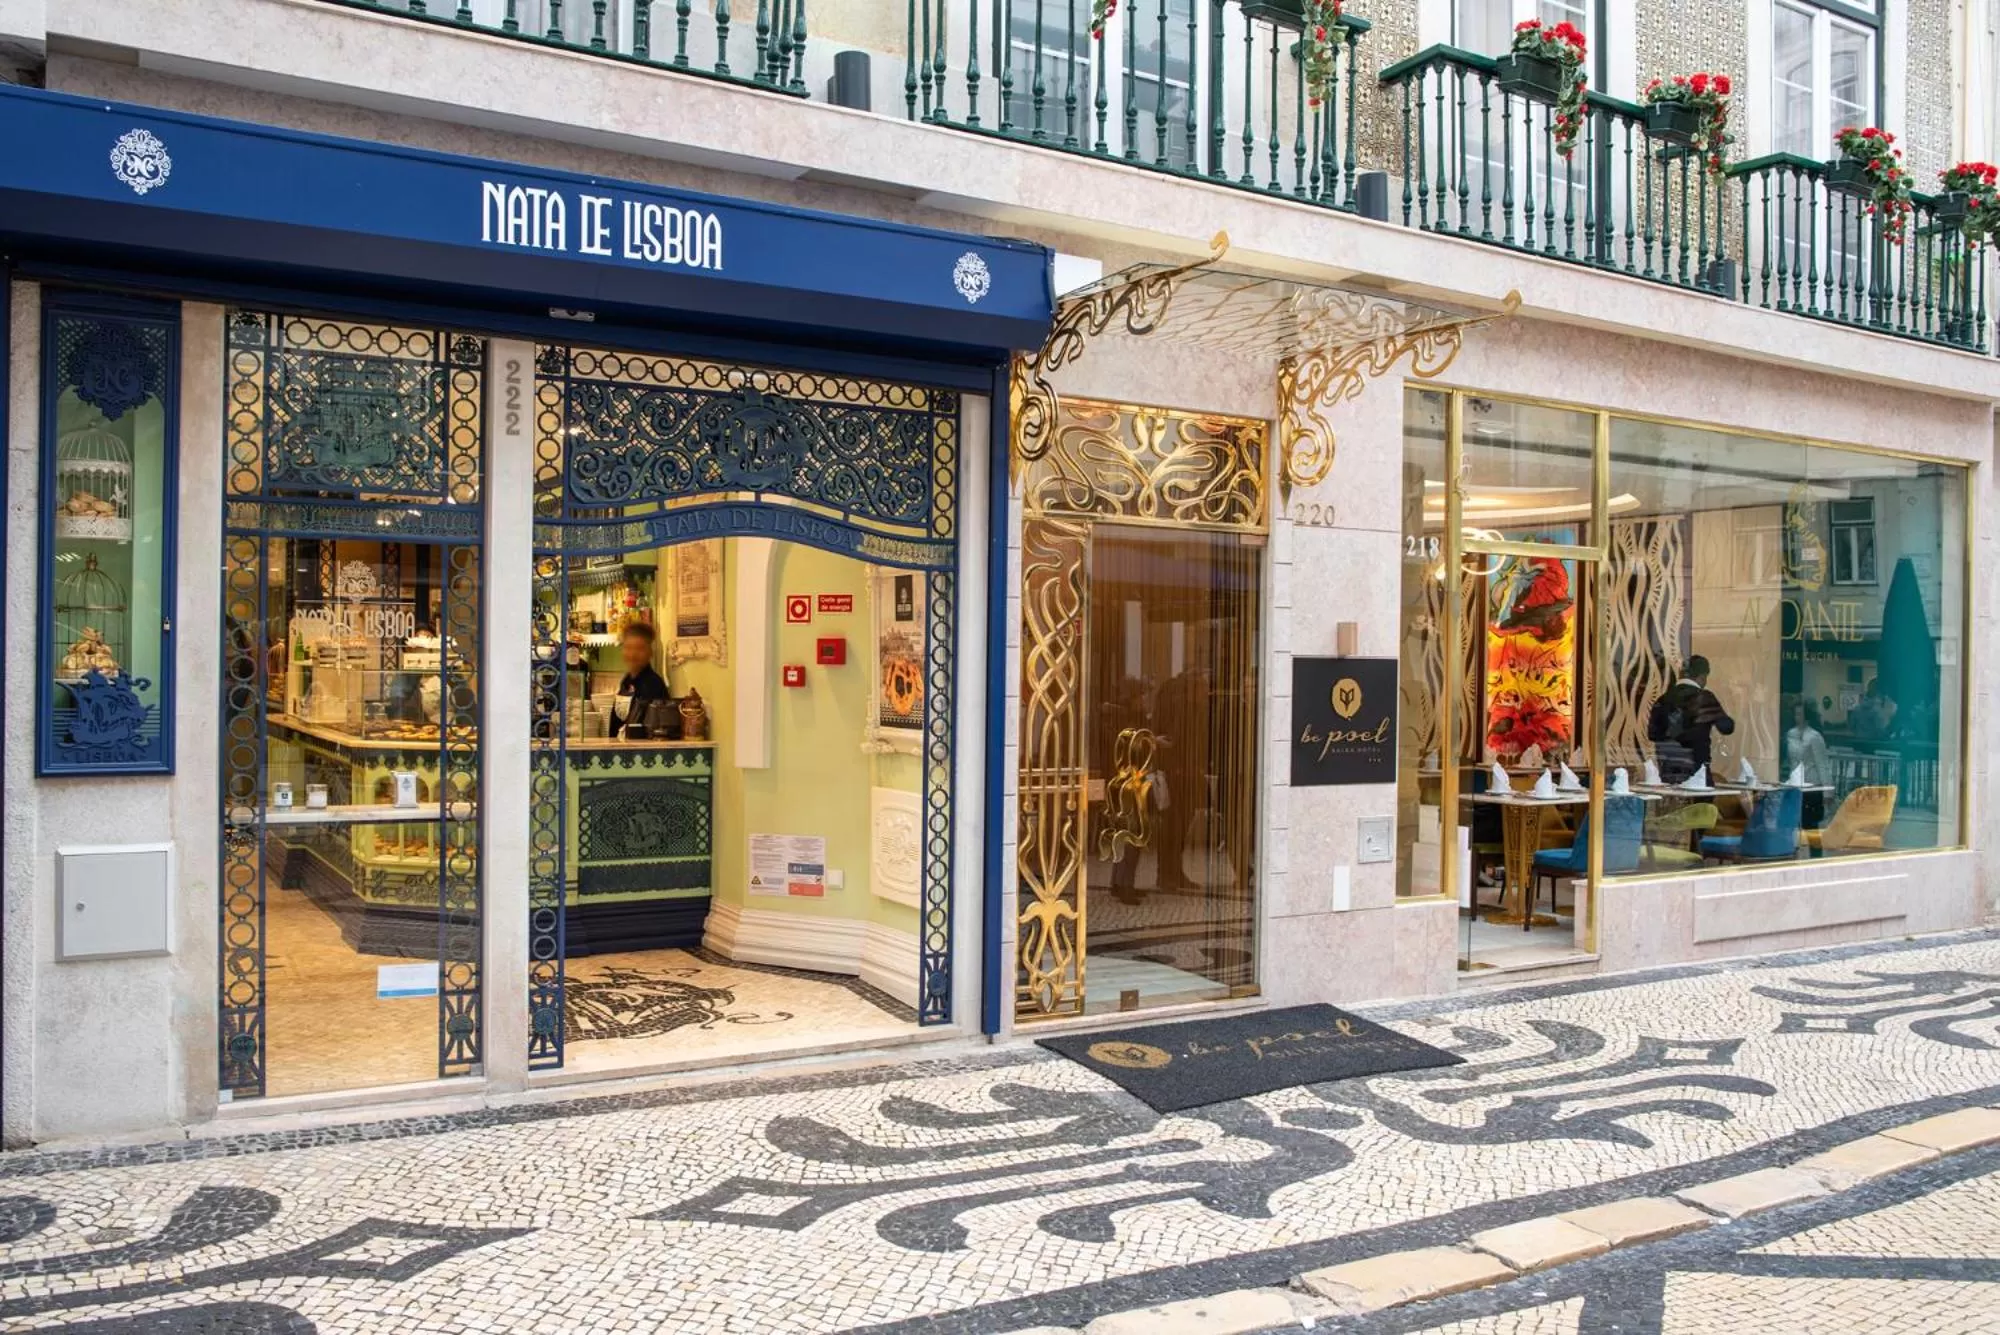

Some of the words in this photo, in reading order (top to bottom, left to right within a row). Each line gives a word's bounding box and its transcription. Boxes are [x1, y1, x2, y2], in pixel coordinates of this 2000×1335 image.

[481, 180, 568, 252] NATA
[578, 194, 613, 257] DE
[622, 200, 724, 271] LISBOA
[505, 359, 522, 436] 222
[650, 509, 724, 540] NATA
[729, 508, 766, 531] DE
[773, 511, 855, 550] LISBOA
[1295, 502, 1336, 527] 220
[1405, 535, 1440, 561] 218
[364, 608, 416, 639] LISBOA
